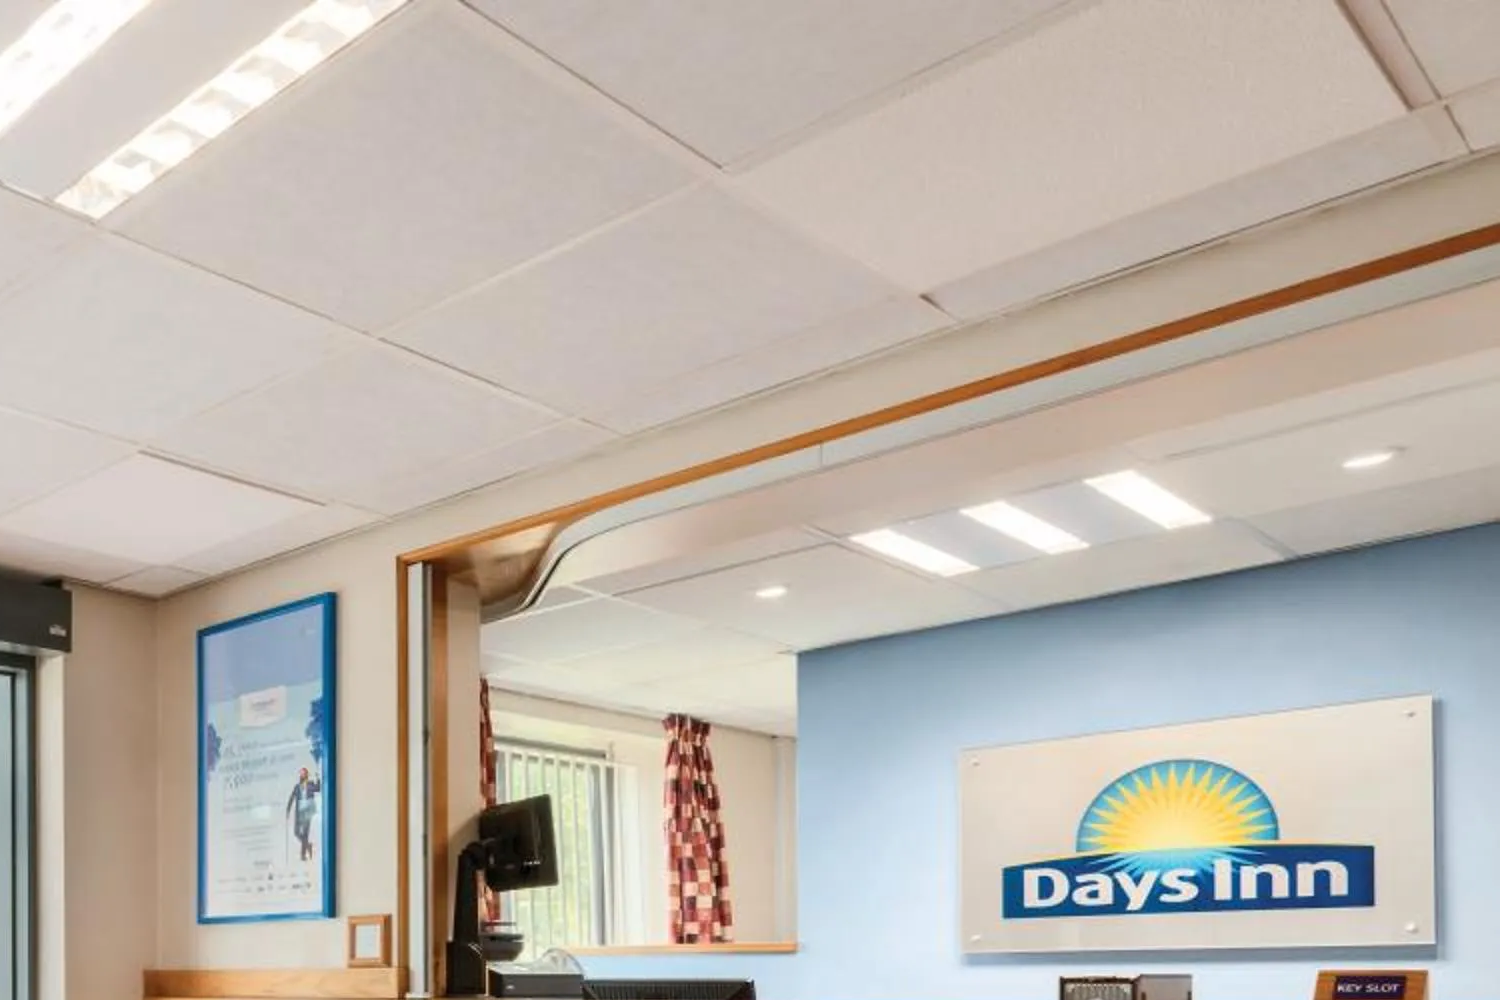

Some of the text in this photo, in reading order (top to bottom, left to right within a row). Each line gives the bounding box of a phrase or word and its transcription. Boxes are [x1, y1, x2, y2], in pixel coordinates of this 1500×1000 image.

[1022, 858, 1349, 911] Days Inn
[1337, 983, 1401, 993] KEY SLOT
